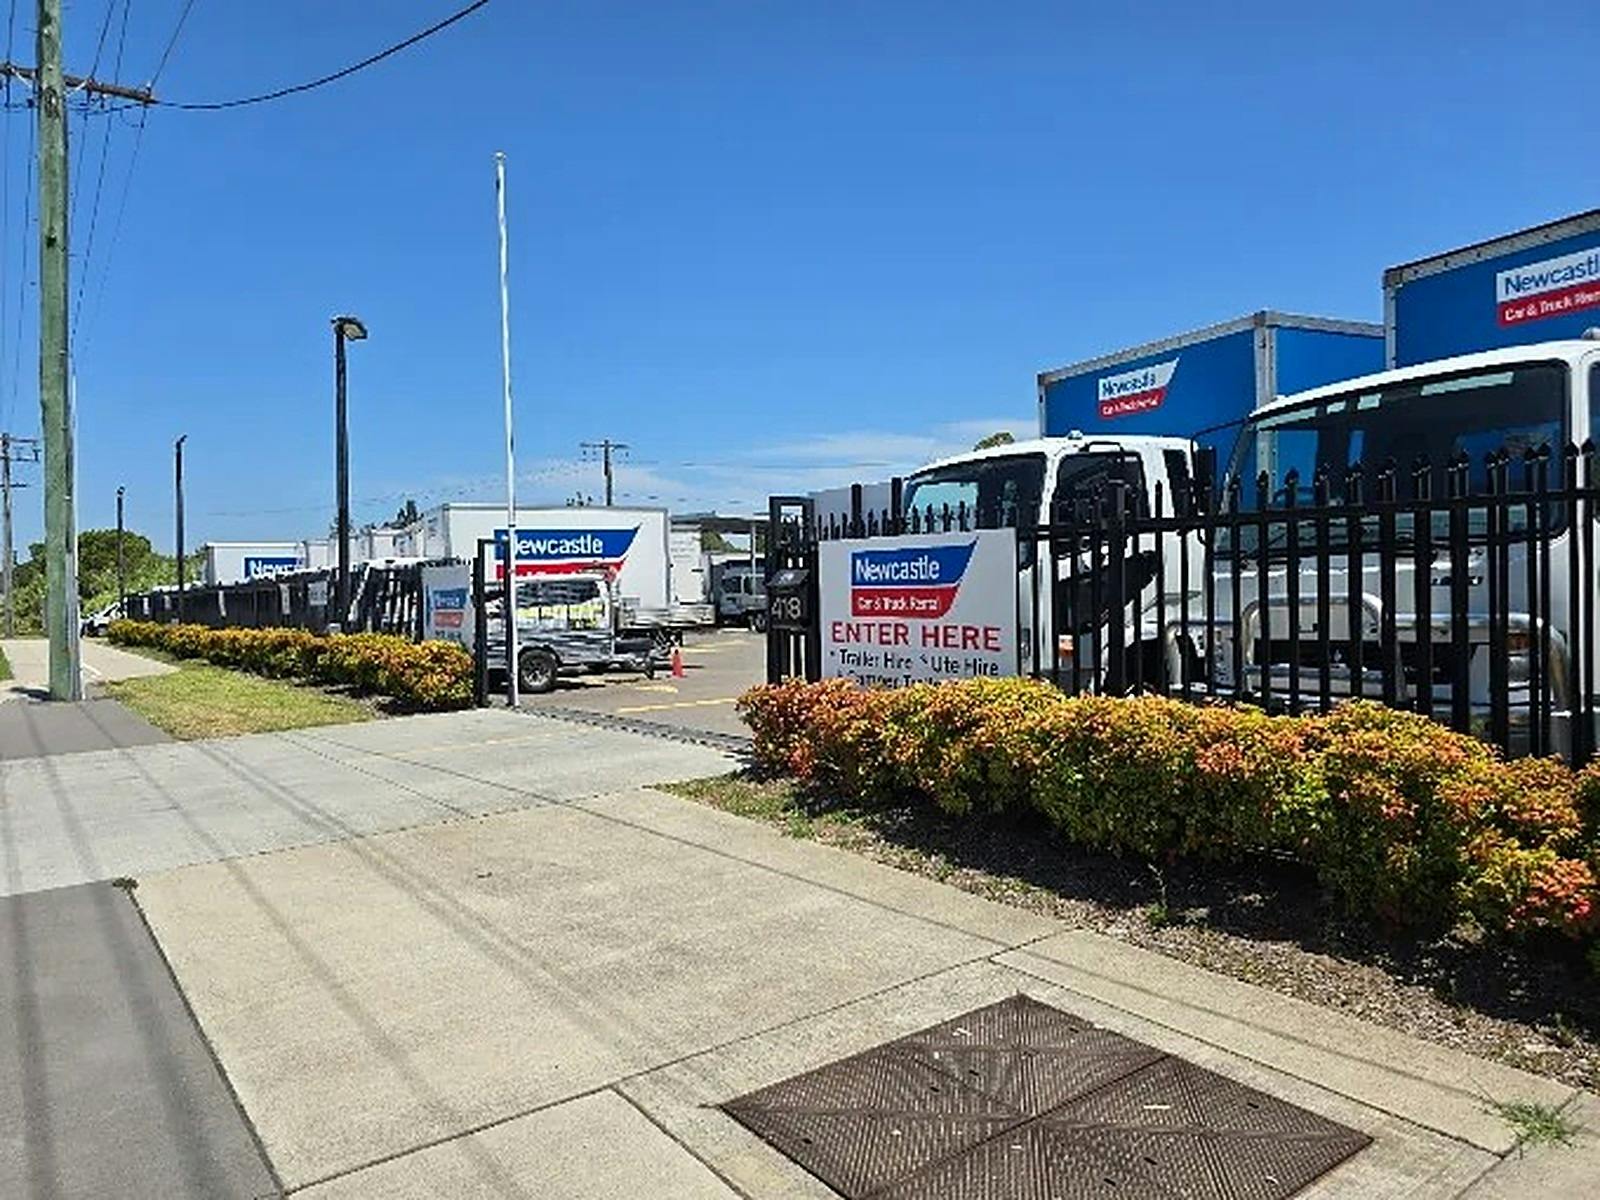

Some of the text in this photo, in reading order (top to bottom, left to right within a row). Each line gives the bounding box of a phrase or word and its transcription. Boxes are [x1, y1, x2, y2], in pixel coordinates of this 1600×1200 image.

[1504, 254, 1600, 295] Newcastl
[856, 555, 940, 581] Newcastle
[771, 597, 801, 620] 418
[831, 622, 1002, 653] ENTER HERE
[883, 652, 914, 670] Hire
[930, 655, 961, 674] Ute
[964, 658, 999, 677] Hire
